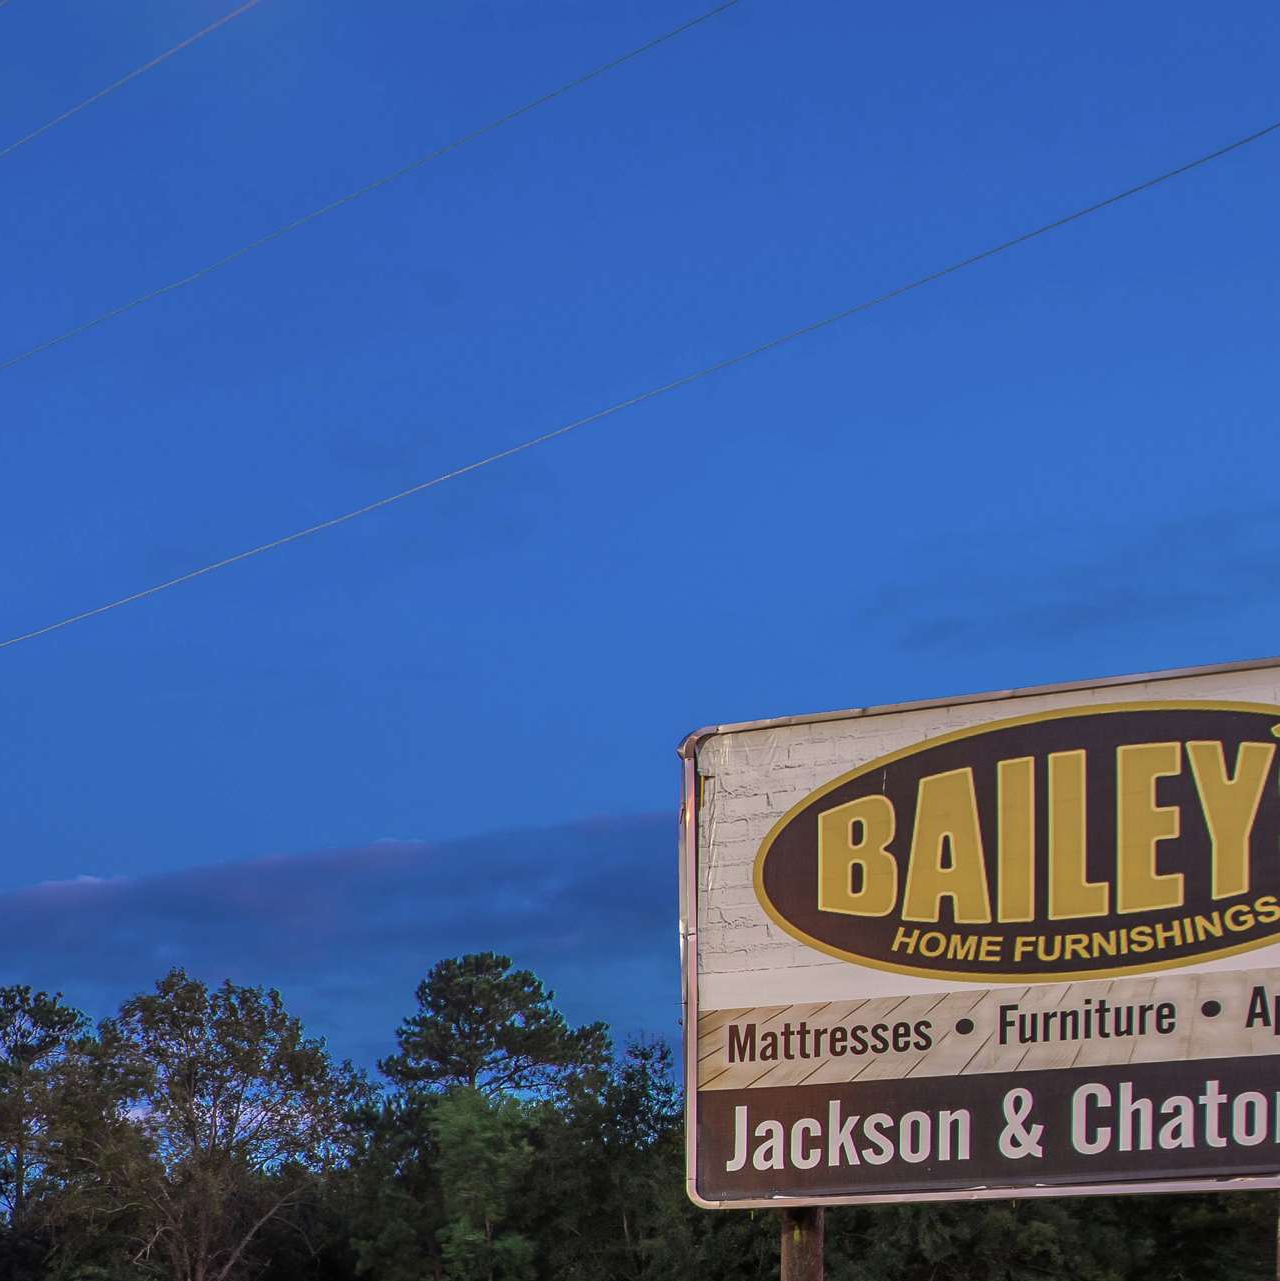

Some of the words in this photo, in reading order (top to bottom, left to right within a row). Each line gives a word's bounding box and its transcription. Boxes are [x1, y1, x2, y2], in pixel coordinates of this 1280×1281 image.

[891, 926, 1004, 962] HOME
[1014, 895, 1280, 962] FURNISHINGS
[727, 1019, 933, 1064] Mattresses
[998, 998, 1177, 1046] Furniture
[726, 1100, 970, 1172] Jackson
[999, 1087, 1045, 1159] &
[1072, 1079, 1280, 1156] Chato
